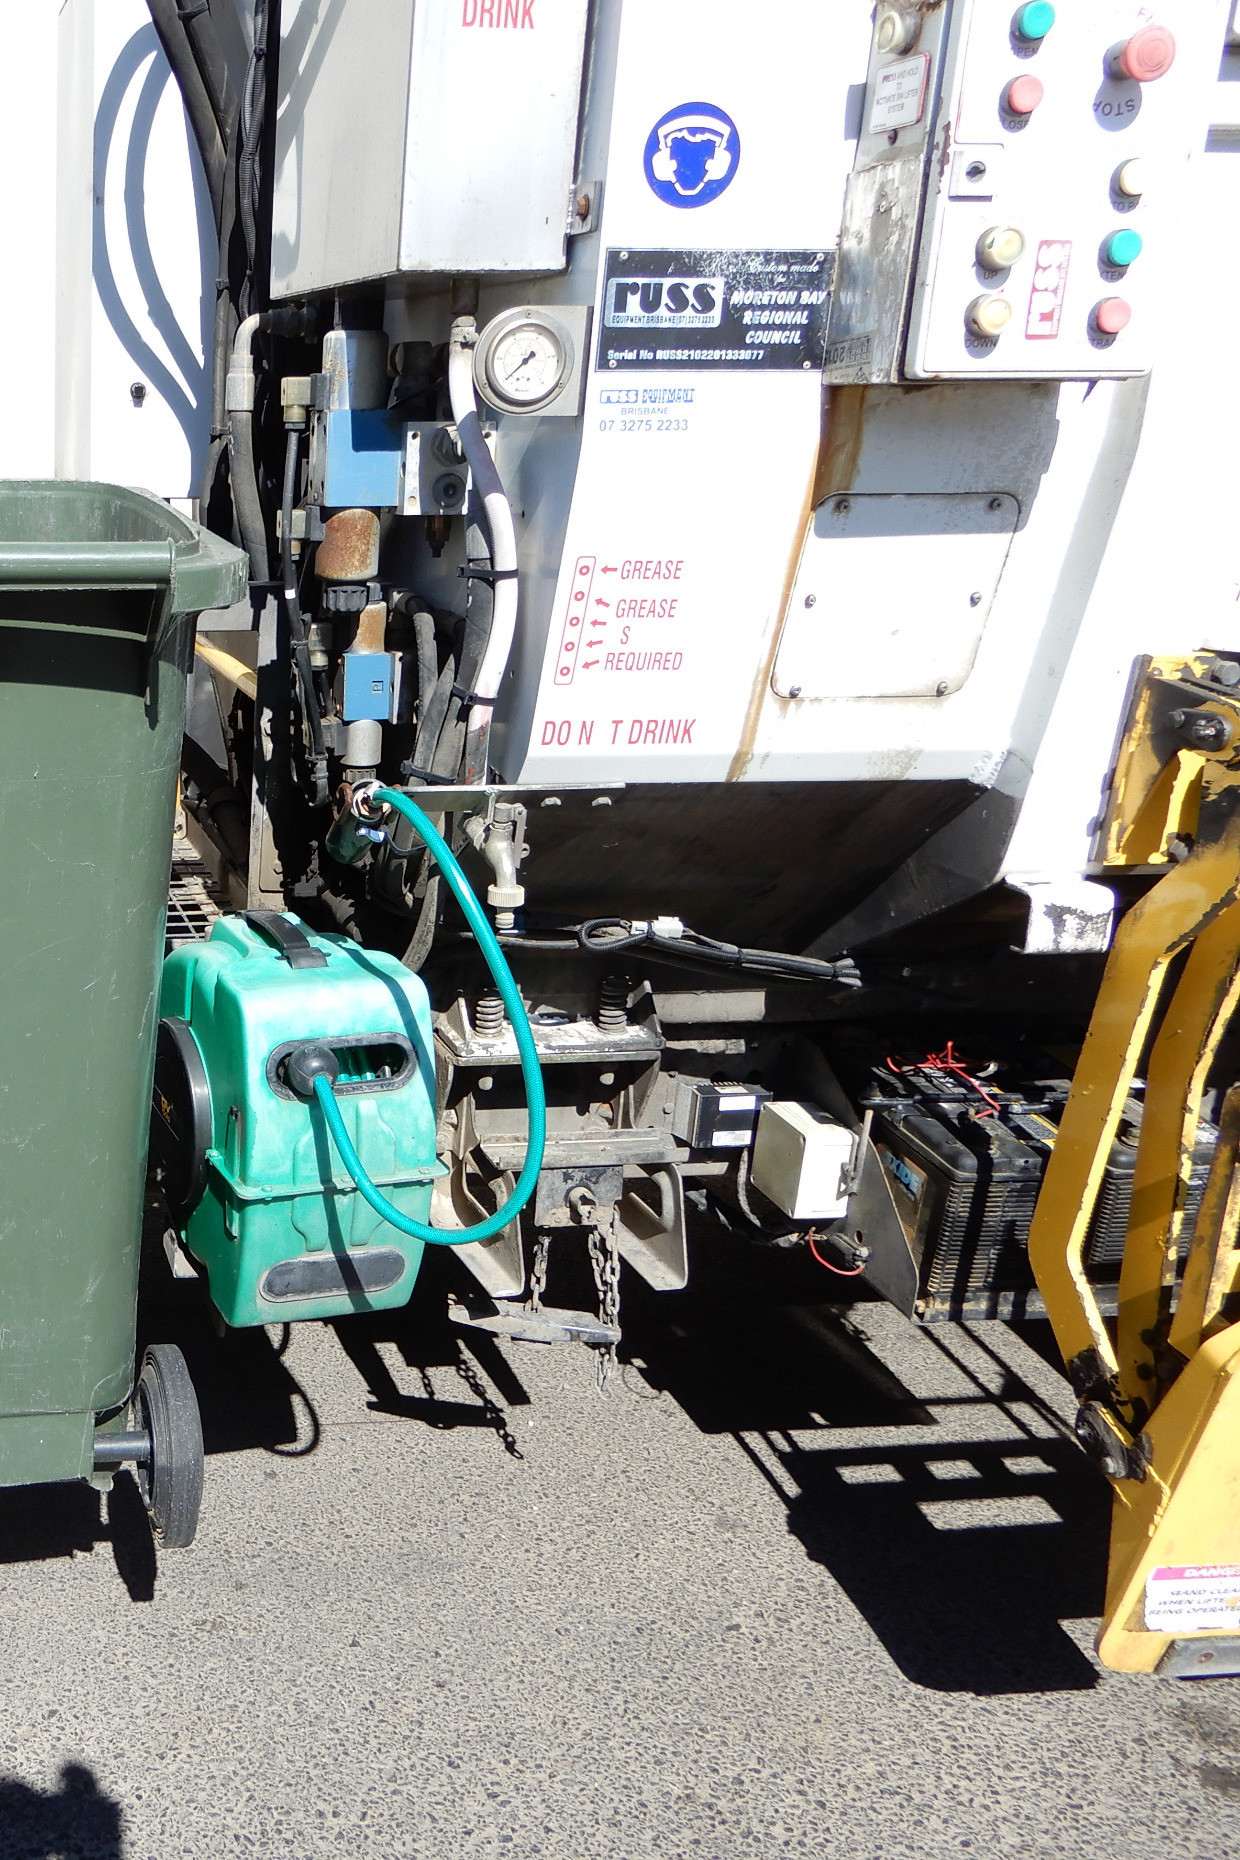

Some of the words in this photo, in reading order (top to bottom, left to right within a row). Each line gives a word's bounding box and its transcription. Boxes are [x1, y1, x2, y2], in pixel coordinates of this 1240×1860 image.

[462, 0, 535, 29] DRINK
[983, 270, 998, 280] UP
[730, 290, 798, 305] MORETON
[799, 290, 828, 305] BAY
[612, 315, 646, 324] EQUIPMENT
[646, 315, 676, 324] BRISBANE
[742, 311, 809, 325] REGIONAL
[745, 331, 802, 344] COUNCIL
[965, 339, 997, 348] DOWN
[607, 350, 636, 360] Serial
[639, 350, 653, 360] No
[642, 388, 695, 404] EQUIPMENT
[621, 407, 668, 415] BRISBANE
[599, 420, 615, 431] 07
[620, 420, 652, 431] 3275
[656, 419, 688, 431] 2233
[621, 560, 683, 580] GREASE
[616, 599, 678, 618] GREASE
[620, 626, 631, 645] S
[604, 652, 683, 671] REQUIRED
[628, 719, 696, 744] DRINK
[1210, 1587, 1240, 1595] CLEA
